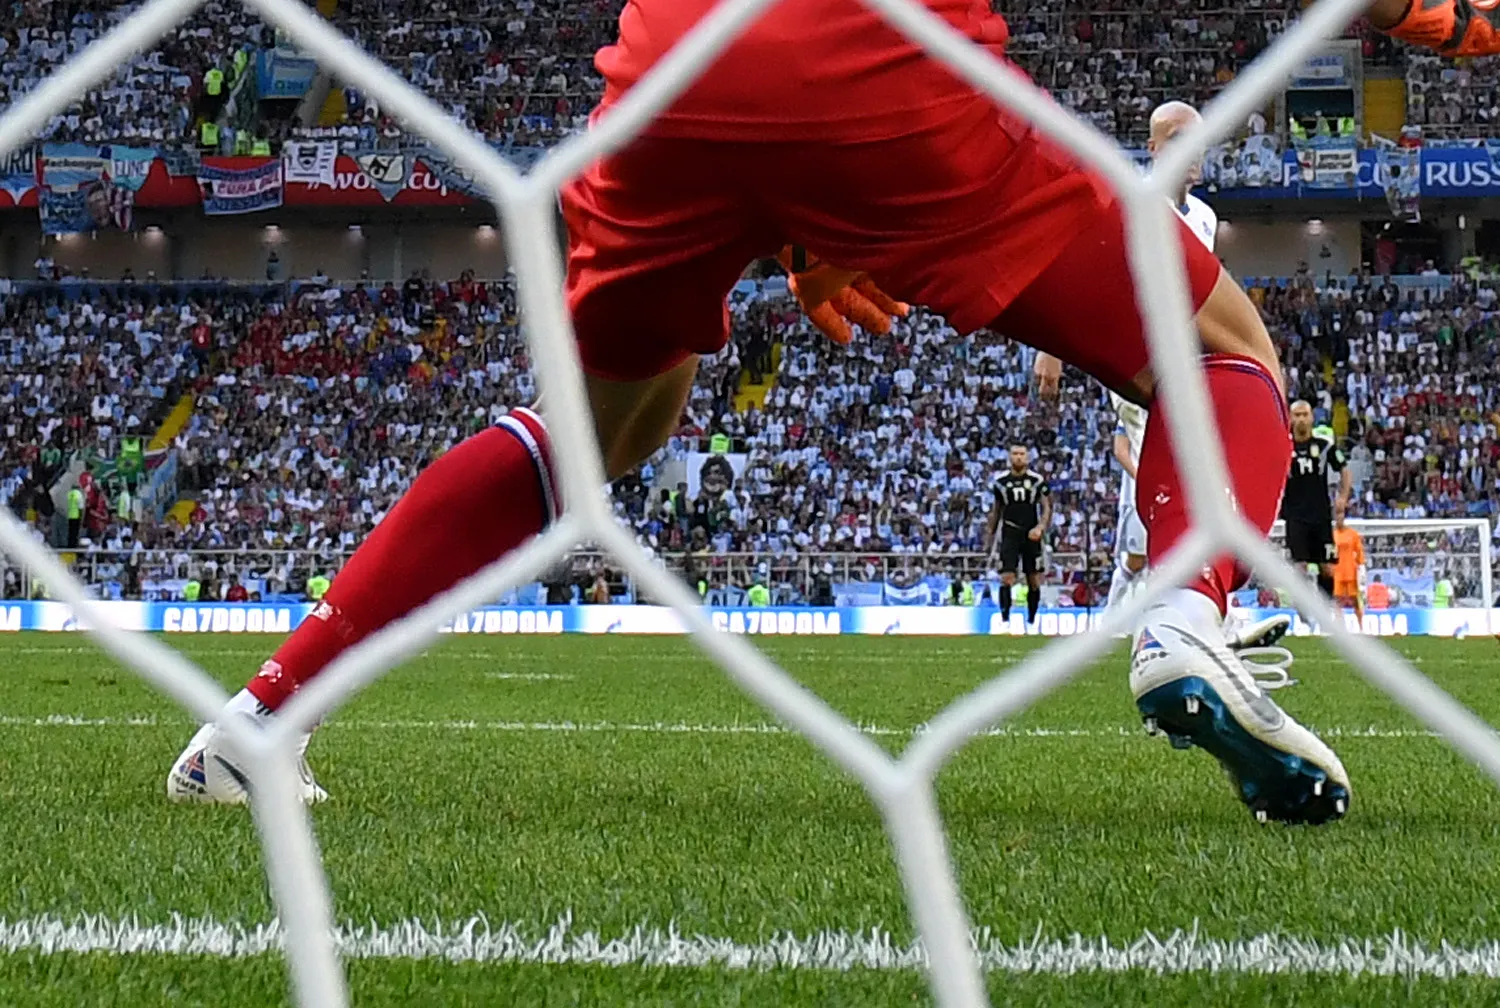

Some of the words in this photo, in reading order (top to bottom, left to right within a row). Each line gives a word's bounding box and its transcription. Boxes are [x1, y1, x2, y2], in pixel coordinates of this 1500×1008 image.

[1297, 457, 1314, 475] 14
[163, 607, 291, 633] GAZPROM
[711, 610, 841, 635] GAZPROM
